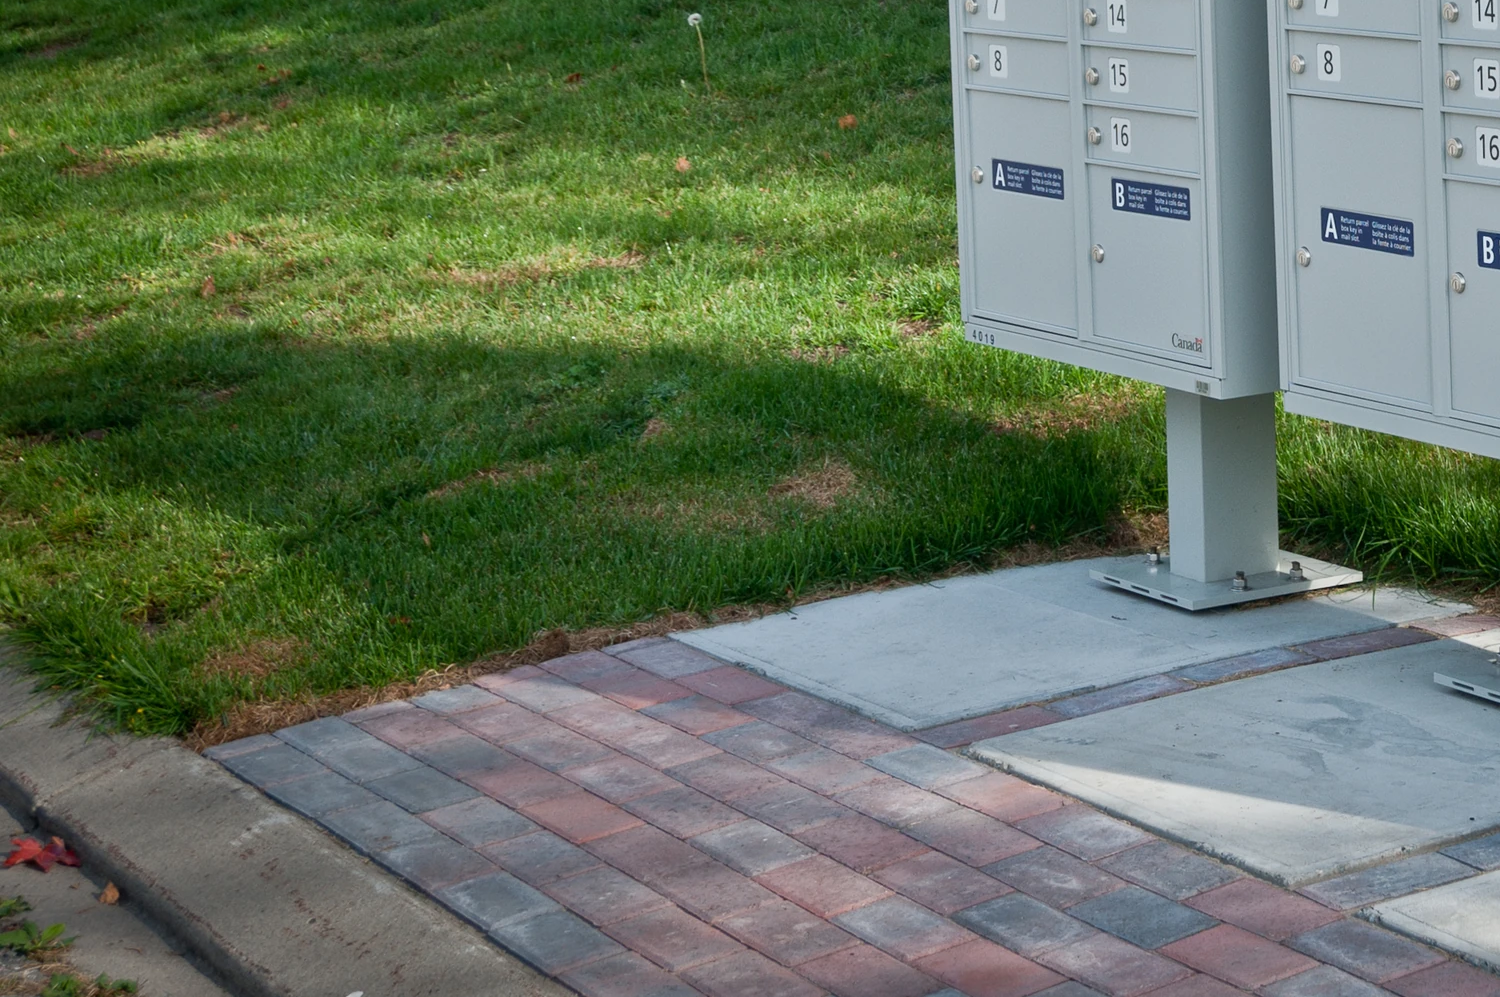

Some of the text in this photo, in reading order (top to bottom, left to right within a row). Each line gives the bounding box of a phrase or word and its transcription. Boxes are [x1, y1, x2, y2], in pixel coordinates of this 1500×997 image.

[1109, 3, 1126, 27] 14
[993, 49, 1003, 72] 8
[1323, 50, 1334, 75] 8
[1110, 63, 1127, 87] 15
[1476, 65, 1497, 92] 15
[1112, 123, 1129, 147] 16
[1479, 133, 1500, 161] 16
[995, 163, 1005, 186] A
[1116, 183, 1125, 207] B
[1325, 212, 1338, 239] A
[1483, 236, 1494, 264] B
[972, 329, 995, 345] 4019
[1172, 333, 1203, 354] Canada
